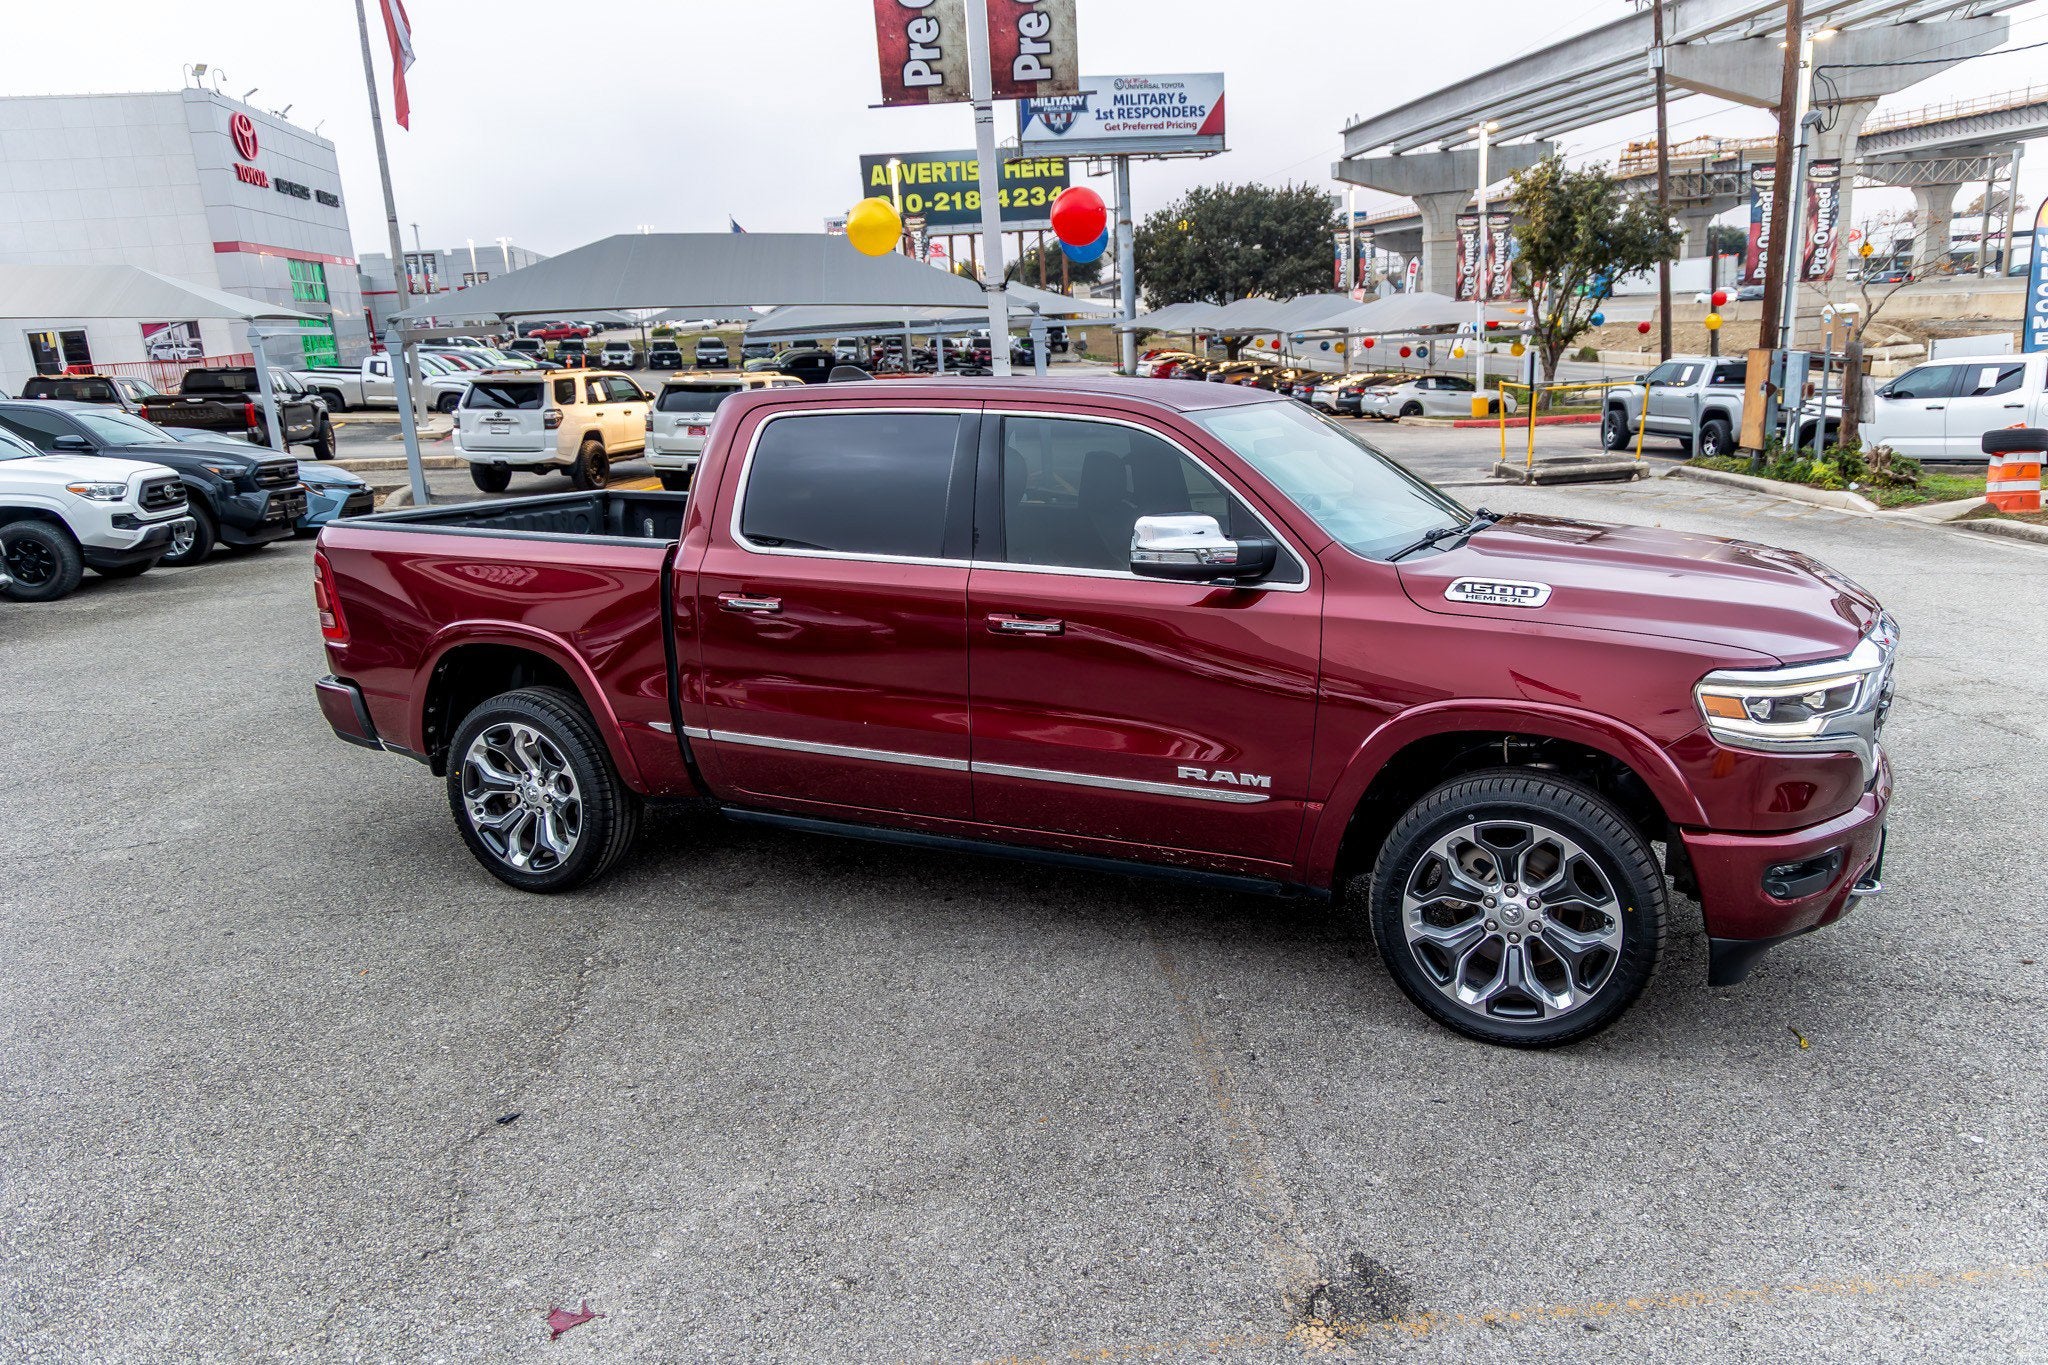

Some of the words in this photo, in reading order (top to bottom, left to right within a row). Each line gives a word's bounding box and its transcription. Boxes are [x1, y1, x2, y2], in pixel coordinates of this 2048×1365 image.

[903, 17, 943, 87] Pre
[1013, 11, 1052, 81] Pre
[1030, 95, 1085, 107] MILITARY
[1113, 92, 1175, 106] MILITARY
[1178, 92, 1187, 104] &
[1095, 108, 1114, 121] 1st
[1117, 105, 1206, 120] RESPONDERS
[1104, 122, 1120, 131] Get
[1122, 122, 1164, 131] Preferred
[1166, 121, 1198, 132] Pricing
[233, 162, 269, 188] TOYOTA
[870, 160, 980, 187] ADVERTIS
[1004, 158, 1065, 180] HERE
[1756, 191, 1774, 248] Owned
[1813, 187, 1832, 245] Owned
[1462, 233, 1475, 275] Owned
[1492, 232, 1505, 274] Owned
[1753, 252, 1768, 279] Pre
[1809, 247, 1828, 275] Pre
[1461, 277, 1474, 297] Pre
[1492, 275, 1504, 296] Pre
[1462, 583, 1536, 598] 1500
[1466, 594, 1496, 602] HEMI
[1499, 596, 1526, 604] 5.7L
[1177, 766, 1271, 788] RAM
